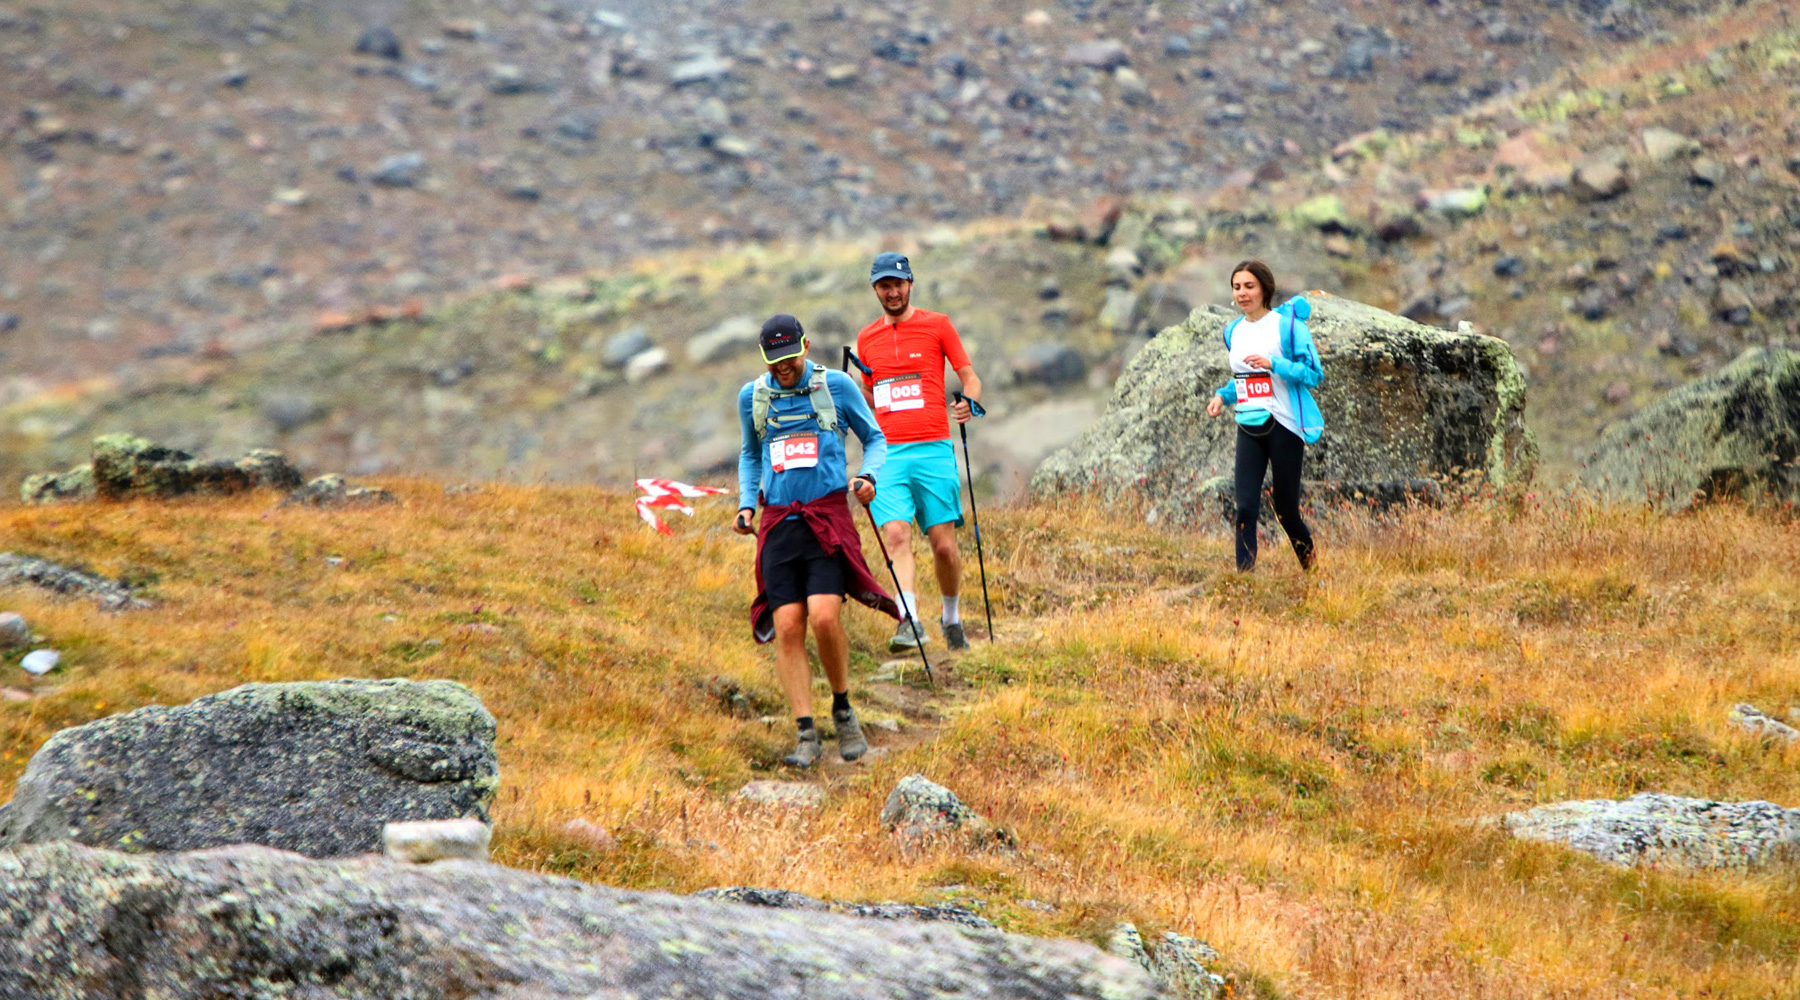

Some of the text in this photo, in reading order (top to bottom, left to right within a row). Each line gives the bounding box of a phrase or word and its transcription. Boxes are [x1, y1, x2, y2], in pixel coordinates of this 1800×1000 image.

[891, 384, 921, 399] 005
[1247, 382, 1270, 394] 109
[785, 442, 816, 456] 042
